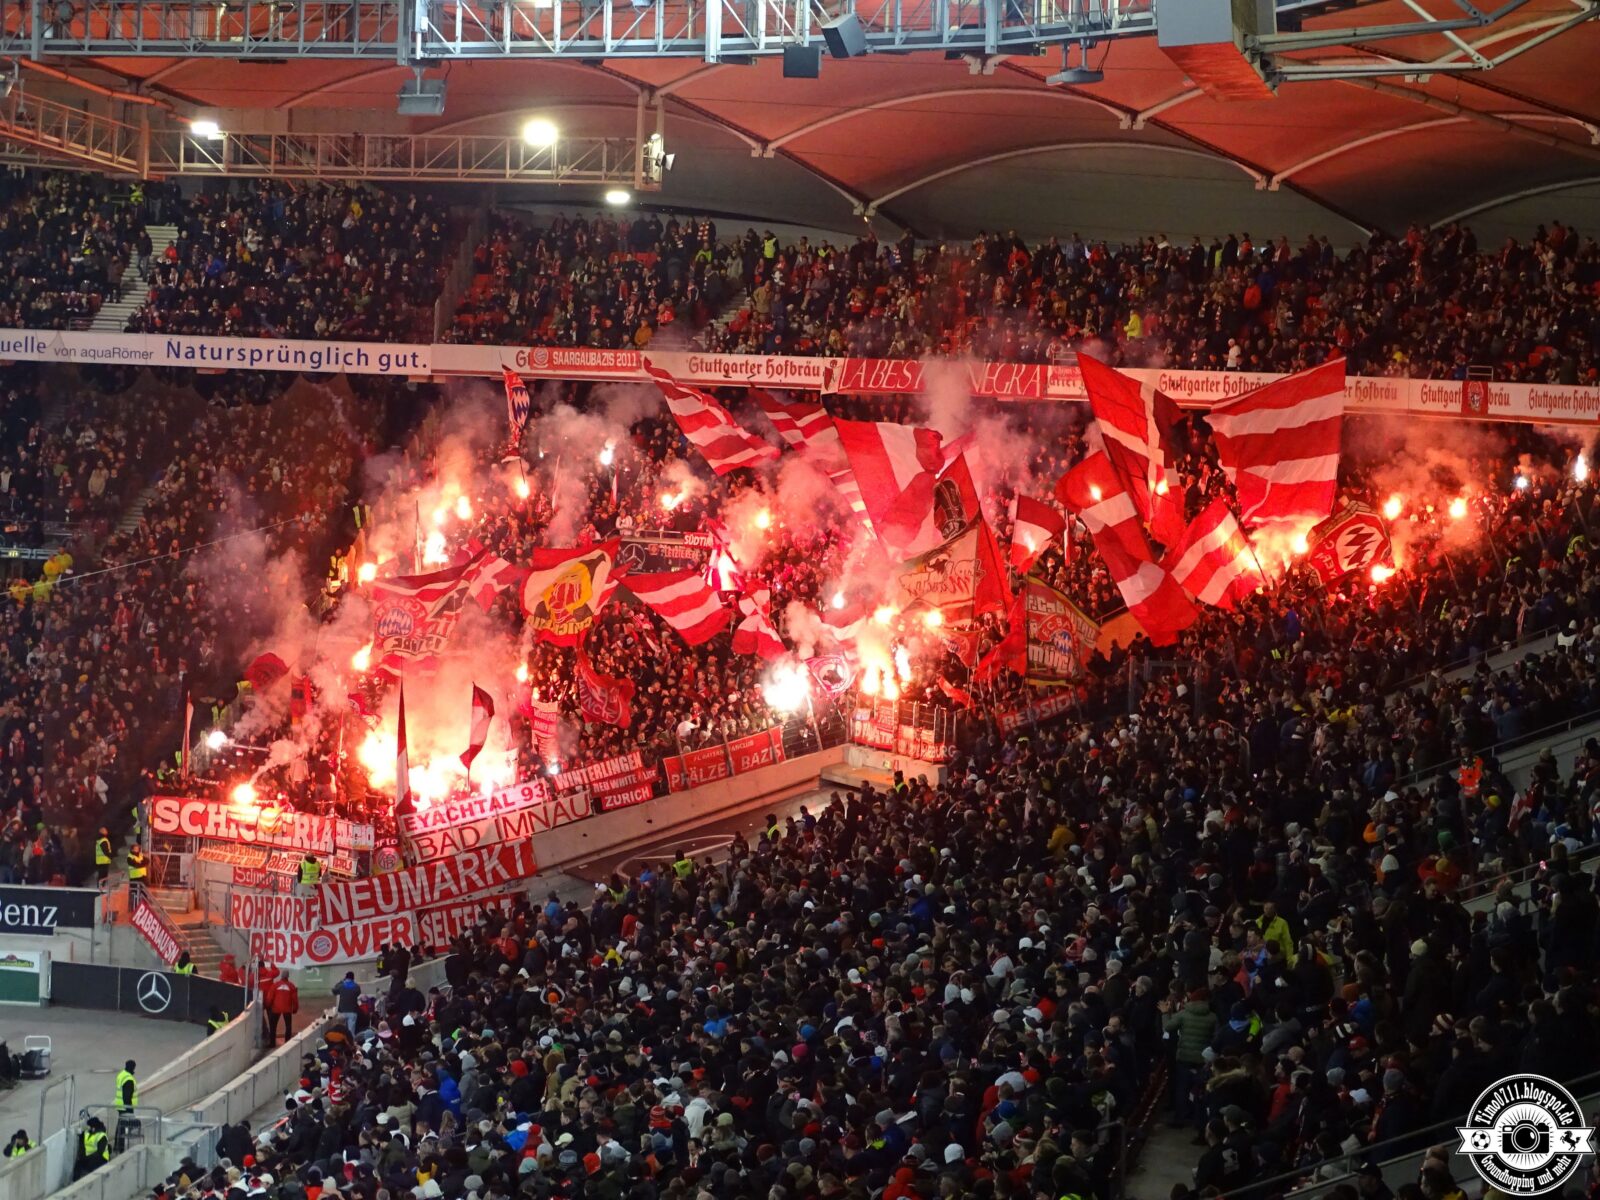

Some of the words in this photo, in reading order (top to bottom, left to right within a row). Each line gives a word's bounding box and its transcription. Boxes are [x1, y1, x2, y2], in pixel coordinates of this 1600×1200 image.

[54, 347, 76, 358] von
[81, 345, 154, 362] aquaRömer
[166, 339, 369, 368] Natursprünglich
[378, 347, 428, 371] gut.
[553, 351, 615, 366] SAARGAUBAZIS
[616, 352, 636, 367] 2011
[688, 356, 762, 376] Stuttgarter
[766, 358, 820, 378] Hofbräu
[1160, 373, 1220, 397] Stuttgarter
[1354, 380, 1398, 404] Hofbräu
[1421, 383, 1463, 408] Stuttgart
[1528, 387, 1571, 414] Stuttgarter
[554, 752, 643, 790] WINTERLINGEN
[404, 793, 515, 833] EYACHTAL
[520, 783, 546, 802] 93
[414, 826, 481, 860] BAD
[495, 794, 591, 839] IMNAU
[322, 839, 528, 924] NEUMARKT
[231, 894, 319, 931] ROHRDORF
